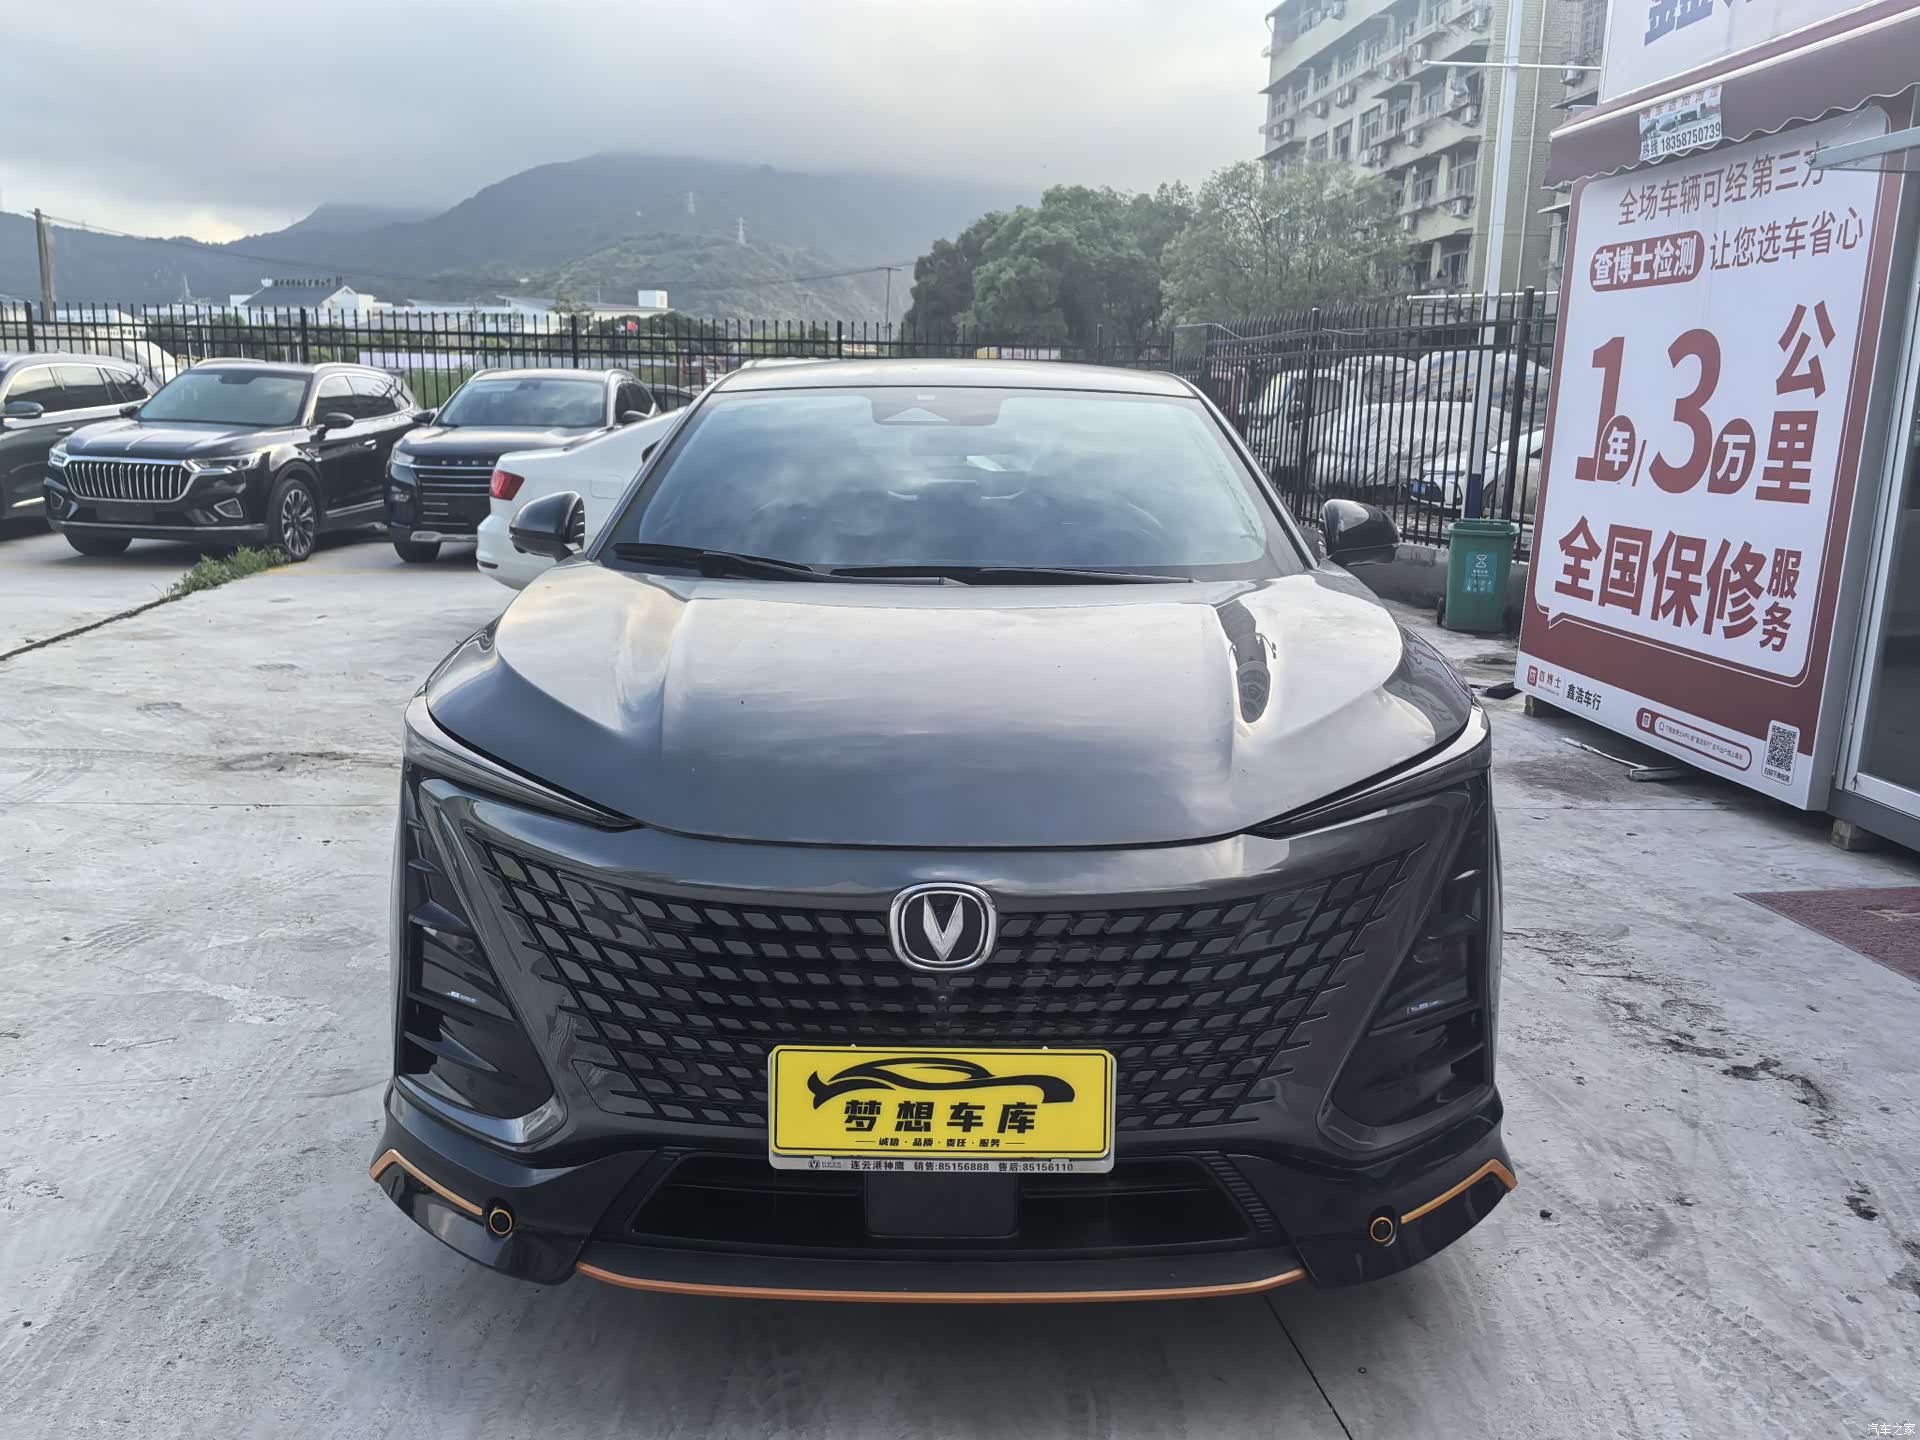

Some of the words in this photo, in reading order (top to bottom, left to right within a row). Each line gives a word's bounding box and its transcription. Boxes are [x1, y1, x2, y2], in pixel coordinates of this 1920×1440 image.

[1661, 122, 1721, 152] 18358750739
[1618, 141, 1829, 225] 全场车辆可经第三方
[1593, 234, 1697, 286] 查博士检测
[1709, 206, 1864, 271] 让您选车省心
[1755, 300, 1836, 504] 公里
[1554, 515, 1767, 639] 全国保修
[1759, 548, 1802, 652] 服务
[1566, 683, 1602, 711] 鑫浩车行
[843, 1099, 1038, 1135] 梦想车库
[850, 1160, 905, 1171] 连云港神鹰
